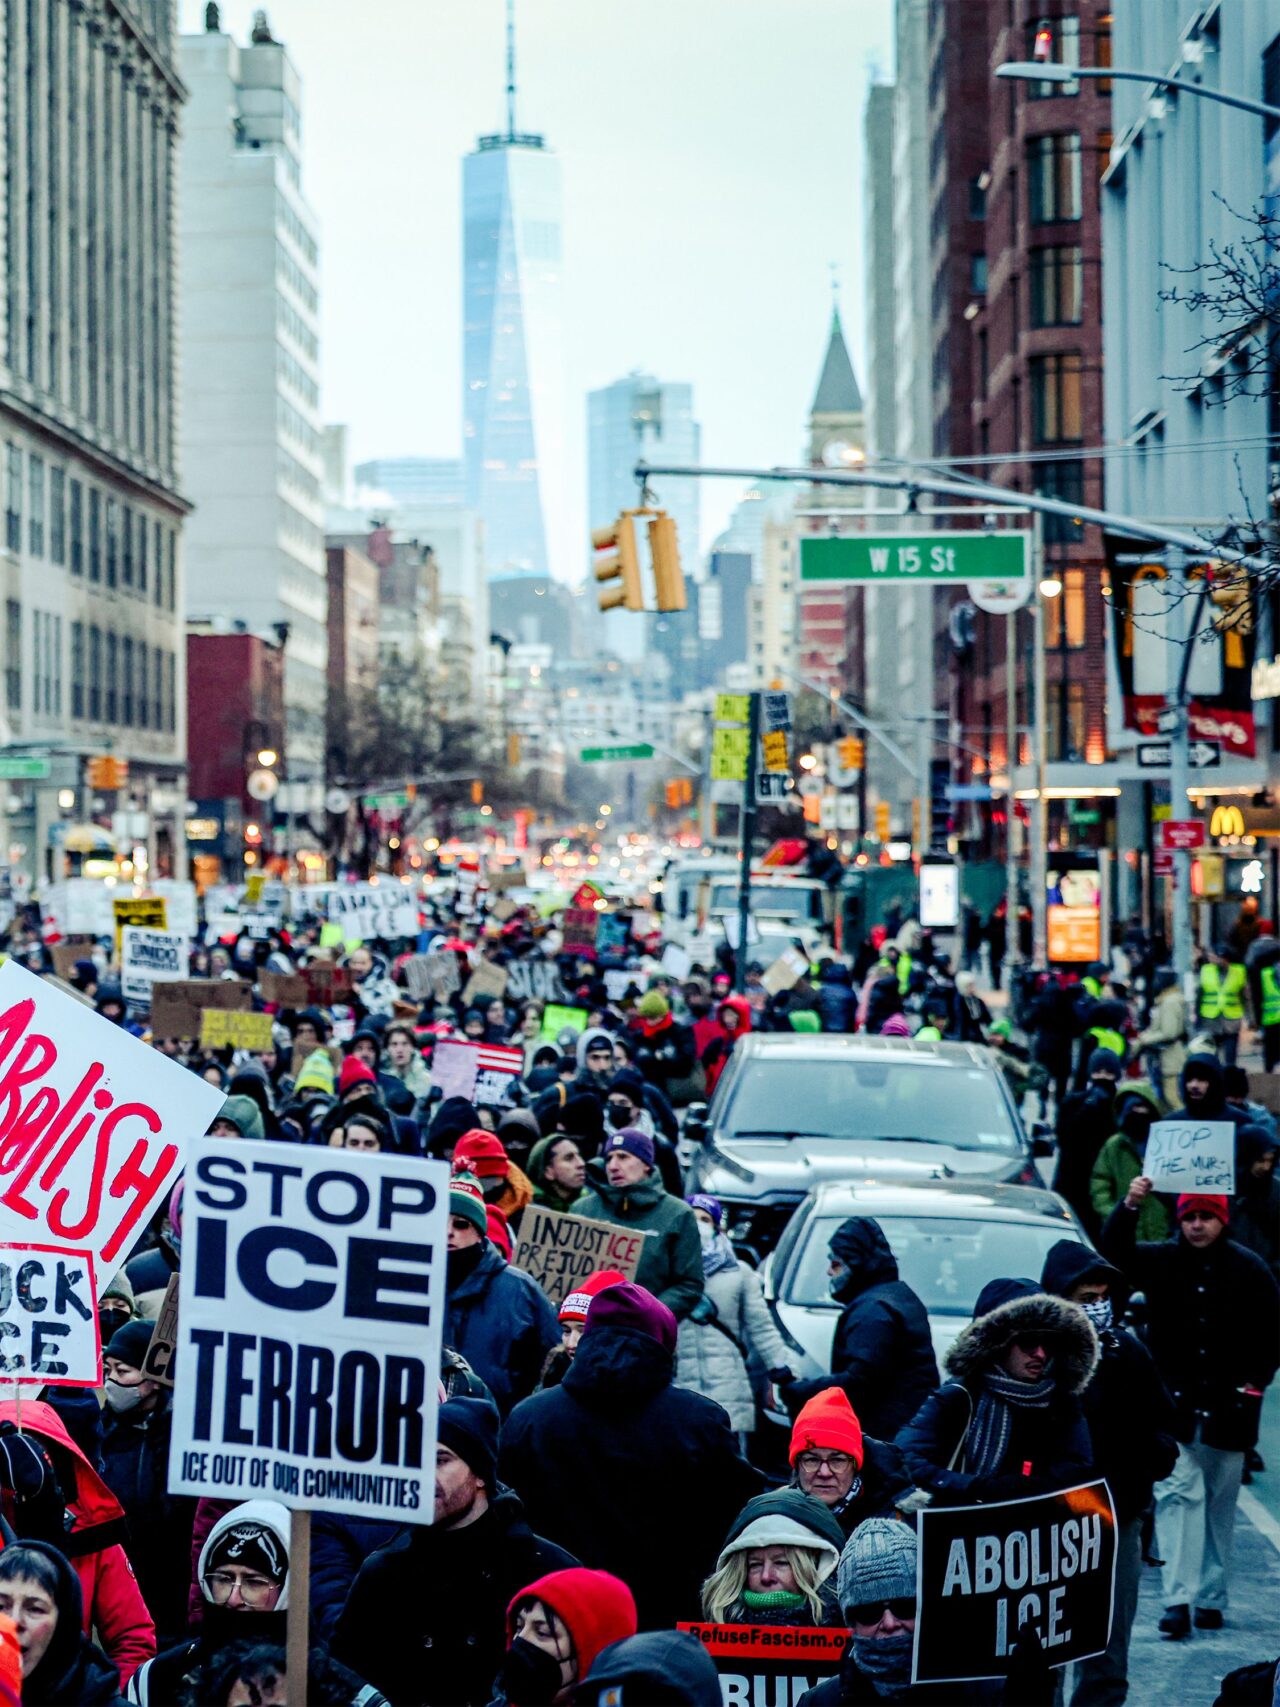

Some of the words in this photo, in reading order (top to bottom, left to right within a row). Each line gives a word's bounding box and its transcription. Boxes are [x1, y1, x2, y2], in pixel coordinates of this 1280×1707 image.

[869, 547, 888, 572] W
[898, 546, 920, 573] 15
[930, 546, 956, 572] St
[1149, 1126, 1212, 1157] STOP
[1152, 1155, 1186, 1177] THE
[193, 1154, 437, 1231] STOP
[531, 1214, 641, 1264] INJUSTICE
[193, 1215, 434, 1328] ICE
[188, 1326, 426, 1470] TERROR
[181, 1450, 208, 1484] ICE
[211, 1454, 246, 1486] OUT
[249, 1457, 270, 1489] OF
[272, 1461, 300, 1497] OUR
[302, 1467, 421, 1512] COMMUNITIES
[941, 1512, 1103, 1598] ABOLISH
[689, 1625, 852, 1651] RefuseFascism.or
